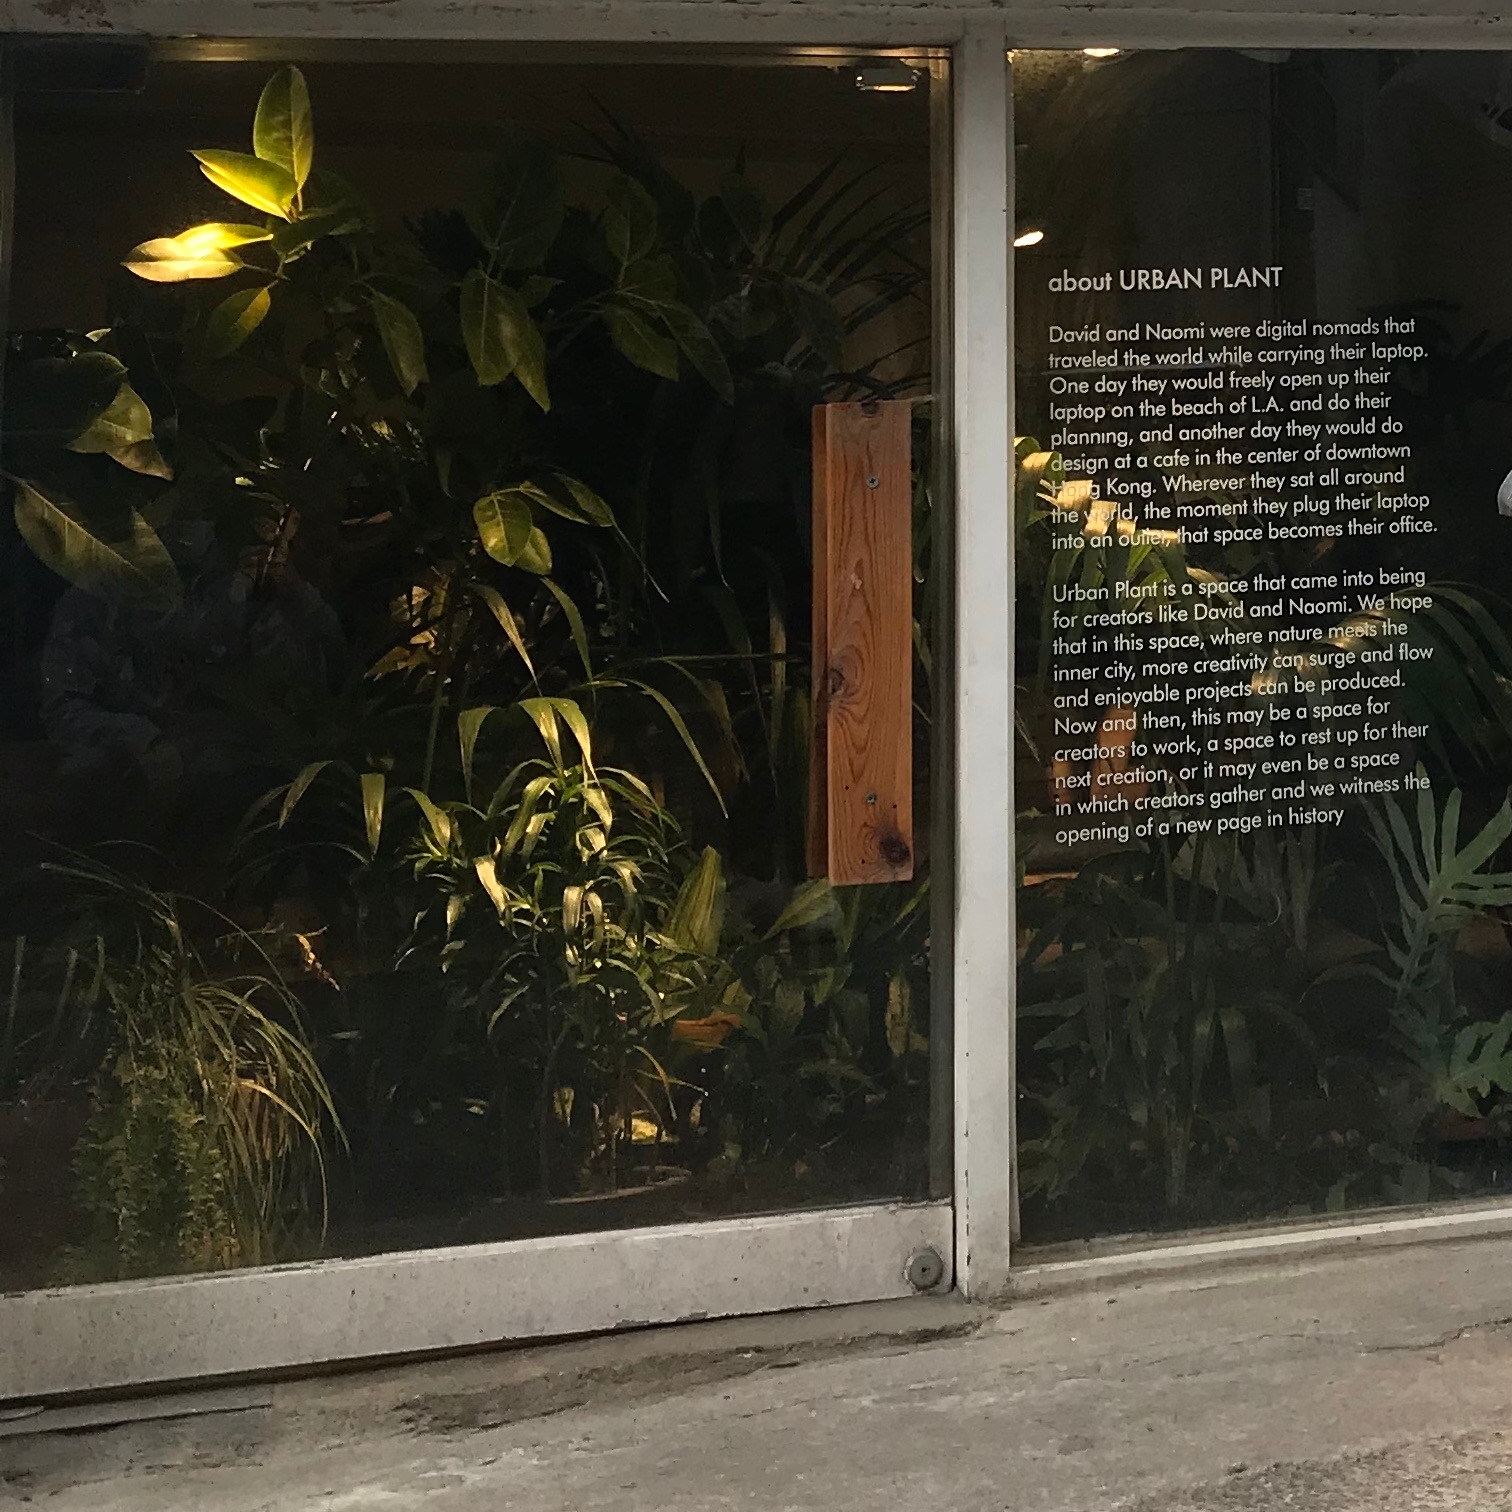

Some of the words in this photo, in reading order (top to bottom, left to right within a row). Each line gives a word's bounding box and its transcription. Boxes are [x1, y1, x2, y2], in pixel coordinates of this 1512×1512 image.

[1049, 270, 1112, 291] about
[1120, 268, 1201, 290] URBAN
[1211, 267, 1282, 288] PLANT
[1050, 324, 1100, 342] David
[1106, 323, 1139, 341] and
[1146, 322, 1204, 340] Naomi
[1210, 326, 1250, 338] were
[1256, 319, 1306, 341] digital
[1313, 317, 1379, 335] nomads
[1384, 317, 1415, 333] that
[1049, 349, 1117, 368] traveled
[1123, 349, 1150, 366] the
[1155, 347, 1202, 364] world
[1208, 346, 1252, 367] while
[1258, 345, 1324, 365] carrying
[1330, 343, 1366, 359] their
[1372, 342, 1428, 362] laptop.
[1050, 377, 1089, 394] One
[1095, 375, 1127, 396] day
[1132, 374, 1167, 395] they
[1172, 371, 1223, 390] would
[1229, 370, 1275, 391] freely
[1280, 374, 1322, 390] open
[1328, 374, 1349, 389] up
[1354, 367, 1391, 384] their
[1050, 403, 1105, 424] laptop
[1112, 406, 1133, 417] on
[1139, 399, 1166, 416] the
[1172, 397, 1223, 415] beach
[1230, 396, 1247, 413] of
[1252, 396, 1284, 412] L.A.
[1290, 394, 1322, 411] and
[1328, 393, 1350, 410] do
[1355, 392, 1391, 409] their
[1051, 428, 1133, 450] planning,
[1140, 424, 1172, 442] and
[1179, 422, 1245, 440] another
[1251, 420, 1282, 441] day
[1286, 419, 1321, 440] they
[1326, 417, 1375, 434] would
[1382, 416, 1403, 433] do
[1051, 453, 1109, 475] design
[1115, 454, 1131, 468] at
[1137, 457, 1147, 468] a
[1154, 449, 1189, 467] cafe
[1195, 449, 1210, 465] in
[1216, 447, 1242, 464] the
[1248, 448, 1299, 463] center
[1304, 443, 1321, 461] of
[1326, 443, 1410, 460] downtown
[1106, 477, 1158, 498] Kong.
[1161, 473, 1247, 493] Wherever
[1250, 471, 1285, 492] they
[1290, 472, 1314, 487] sat
[1320, 468, 1338, 485] all
[1345, 466, 1404, 485] around
[1051, 508, 1079, 524] the
[1144, 501, 1171, 519] the
[1177, 500, 1248, 517] moment
[1253, 497, 1288, 517] they
[1294, 495, 1329, 517] plug
[1335, 493, 1372, 510] their
[1378, 492, 1429, 512] laptop
[1052, 531, 1084, 549] into
[1090, 536, 1112, 548] an
[1176, 525, 1209, 544] that
[1214, 528, 1262, 546] space
[1268, 522, 1343, 539] becomes
[1348, 518, 1384, 535] their
[1389, 515, 1437, 533] office.
[1053, 583, 1108, 602] Urban
[1116, 580, 1158, 600] Plant
[1164, 579, 1176, 596] is
[1182, 584, 1192, 595] a
[1199, 581, 1248, 598] space
[1253, 574, 1286, 591] that
[1291, 576, 1337, 589] came
[1343, 570, 1373, 586] into
[1380, 567, 1425, 587] being
[1053, 610, 1078, 628] for
[1084, 610, 1152, 627] creators
[1159, 605, 1188, 622] like
[1195, 600, 1243, 620] David
[1250, 598, 1282, 617] and
[1290, 595, 1352, 615] Naomi.
[1357, 594, 1386, 610] We
[1390, 593, 1432, 613] hope
[1053, 637, 1087, 655] that
[1093, 635, 1107, 652] in
[1114, 633, 1143, 651] this
[1149, 636, 1204, 653] space,
[1210, 627, 1262, 645] where
[1269, 626, 1322, 642] nature
[1328, 622, 1378, 639] meets
[1382, 618, 1407, 635] the
[1054, 664, 1099, 681] inner
[1105, 661, 1135, 682] city,
[1143, 662, 1188, 676] more
[1194, 653, 1268, 673] creativity
[1273, 655, 1303, 670] can
[1310, 652, 1355, 668] surge
[1361, 644, 1393, 663] and
[1399, 643, 1433, 660] flow
[1054, 688, 1088, 708] and
[1095, 683, 1179, 708] enjoyable
[1186, 681, 1253, 704] projects
[1258, 680, 1288, 695] can
[1294, 676, 1315, 692] be
[1321, 669, 1405, 695] produced.
[1055, 718, 1097, 735] Now
[1103, 712, 1136, 731] and
[1142, 711, 1186, 730] then,
[1192, 708, 1221, 726] this
[1227, 710, 1264, 726] may
[1270, 703, 1290, 720] be
[1296, 708, 1307, 719] a
[1313, 704, 1361, 722] space
[1367, 696, 1390, 714] for
[1055, 744, 1125, 761] creators
[1131, 741, 1147, 756] to
[1153, 735, 1201, 755] work,
[1208, 740, 1218, 751] a
[1225, 736, 1274, 754] space
[1279, 731, 1295, 746] to
[1302, 728, 1331, 744] rest
[1337, 730, 1358, 746] up
[1364, 722, 1387, 740] for
[1392, 721, 1429, 738] their
[1056, 771, 1091, 788] next
[1097, 765, 1173, 786] creation,
[1180, 767, 1198, 780] or
[1204, 761, 1213, 778] it
[1220, 763, 1256, 779] may
[1262, 760, 1301, 774] even
[1308, 753, 1328, 770] be
[1334, 757, 1344, 769] a
[1351, 753, 1399, 771] space
[1056, 798, 1071, 815] in
[1077, 793, 1128, 813] which
[1135, 792, 1204, 810] creators
[1210, 784, 1266, 808] gather
[1272, 780, 1304, 799] and
[1310, 784, 1334, 796] we
[1339, 777, 1399, 794] witness
[1404, 772, 1430, 789] the
[1056, 822, 1129, 846] opening
[1136, 817, 1153, 836] of
[1159, 823, 1169, 835] a
[1177, 820, 1212, 833] new
[1218, 816, 1261, 835] page
[1268, 809, 1282, 826] in
[1289, 807, 1344, 826] history
